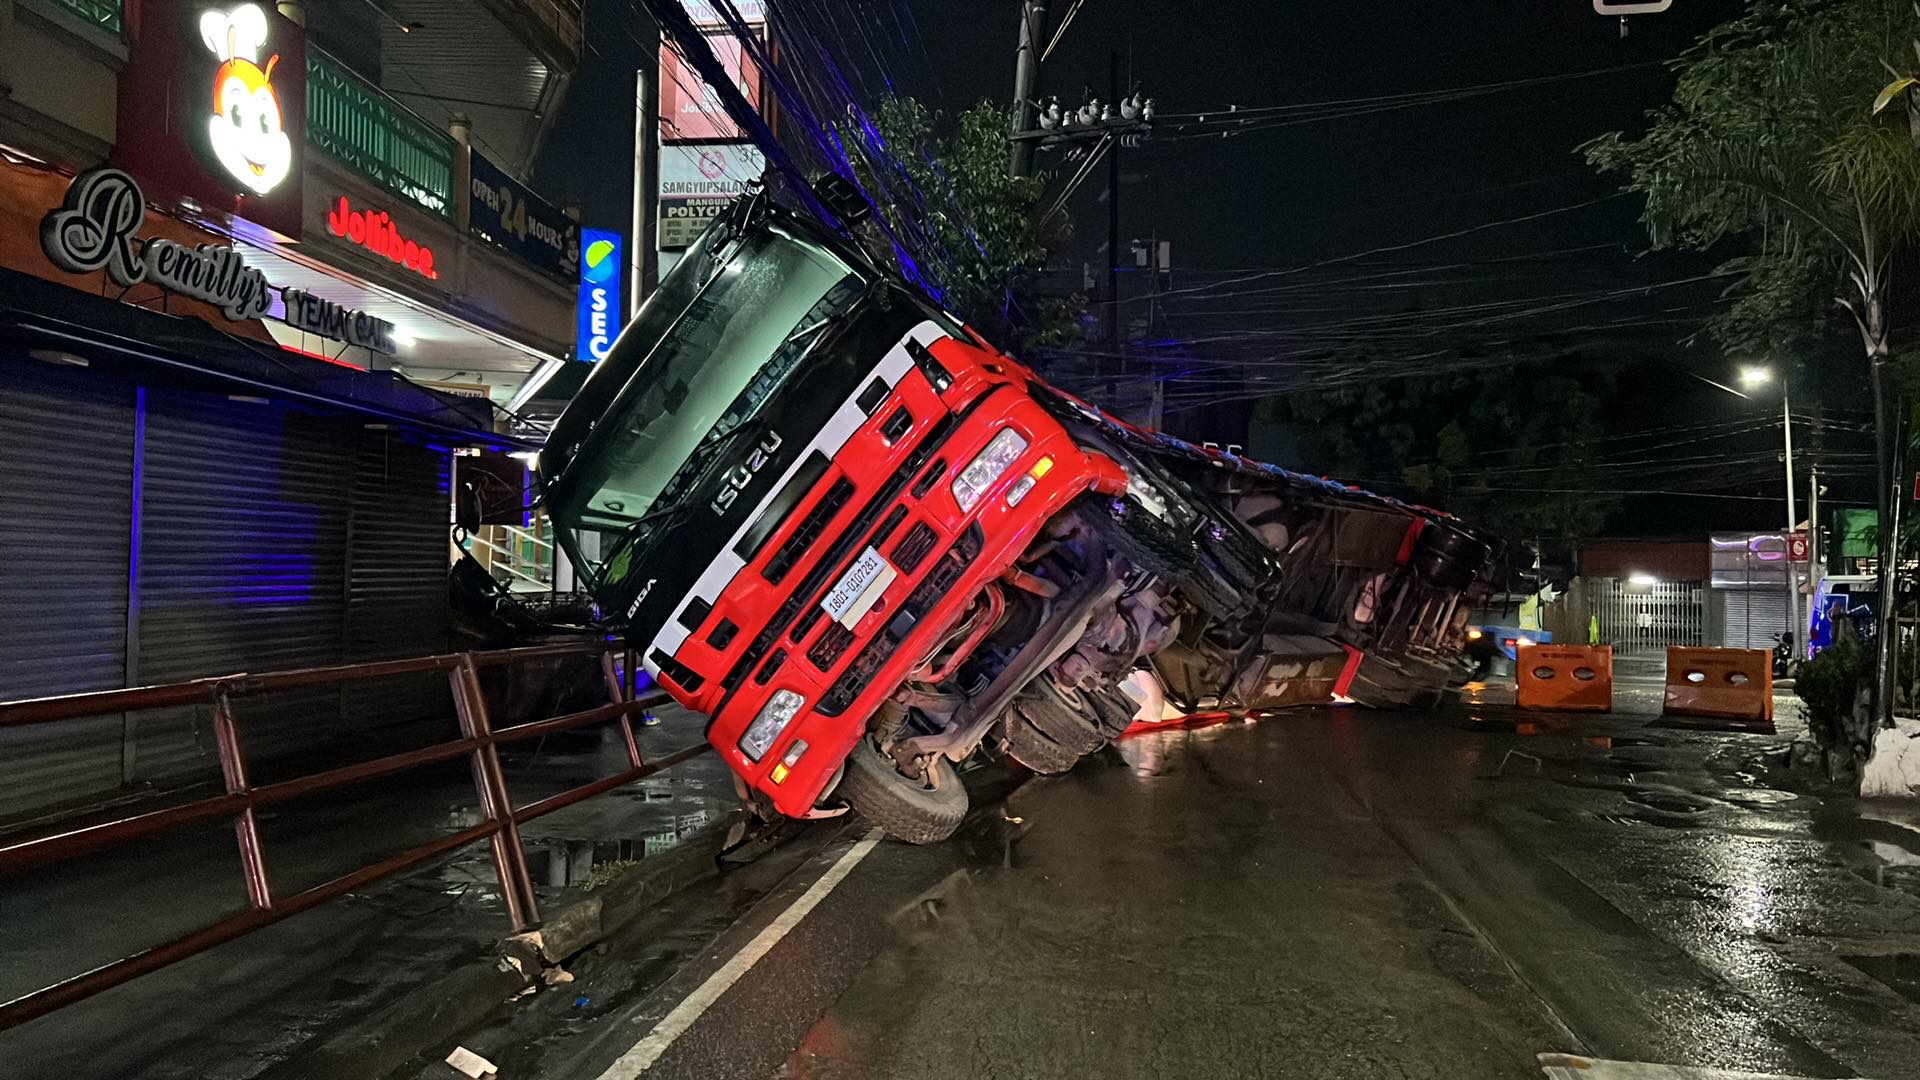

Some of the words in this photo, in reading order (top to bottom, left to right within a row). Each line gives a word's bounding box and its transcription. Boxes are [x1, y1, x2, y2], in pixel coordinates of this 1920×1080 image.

[61, 172, 270, 315] Remilly's
[328, 195, 434, 280] Jollibee
[472, 178, 500, 213] OPEN
[501, 186, 528, 242] 24
[528, 215, 563, 251] HOURS
[294, 289, 346, 340] YEMA
[589, 287, 609, 362] SEC
[710, 429, 783, 517] ISUZU
[626, 578, 658, 620] GIGA
[828, 556, 879, 614] 1801-0107281
